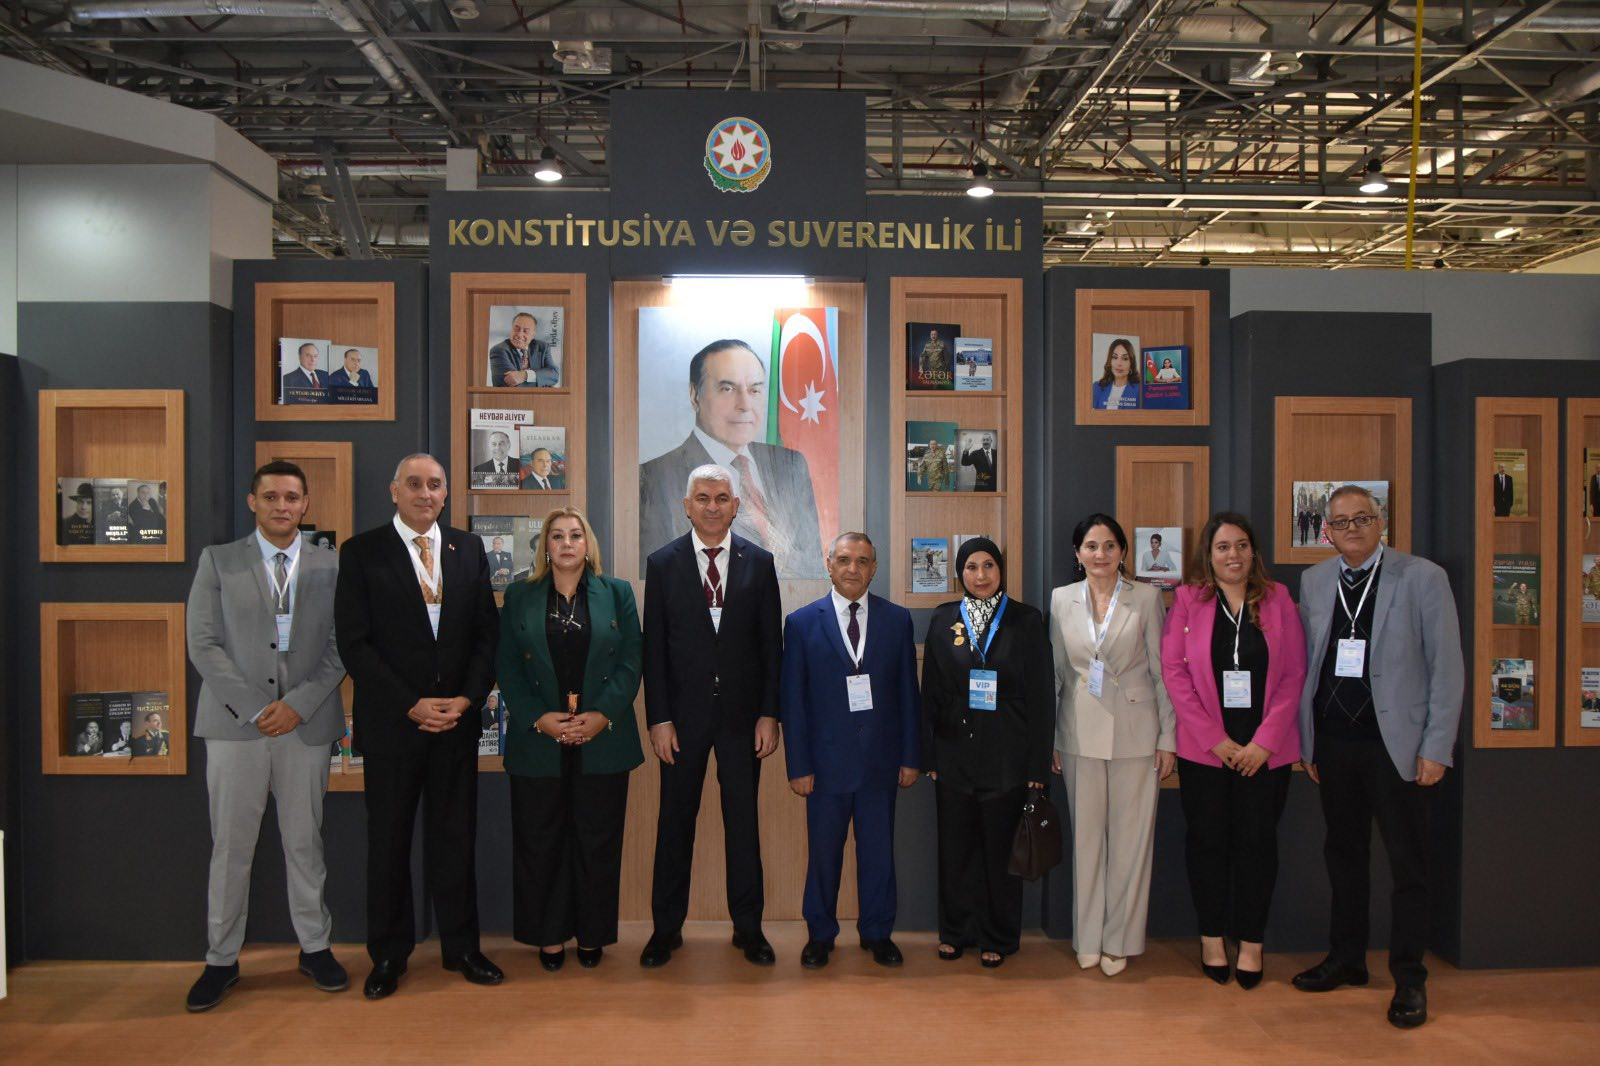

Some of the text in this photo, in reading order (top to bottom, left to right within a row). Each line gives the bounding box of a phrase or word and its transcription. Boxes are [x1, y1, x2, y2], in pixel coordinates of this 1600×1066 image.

[449, 213, 1022, 250] KONSTİTUSİYA VƏ SUVERENLİK İLİ
